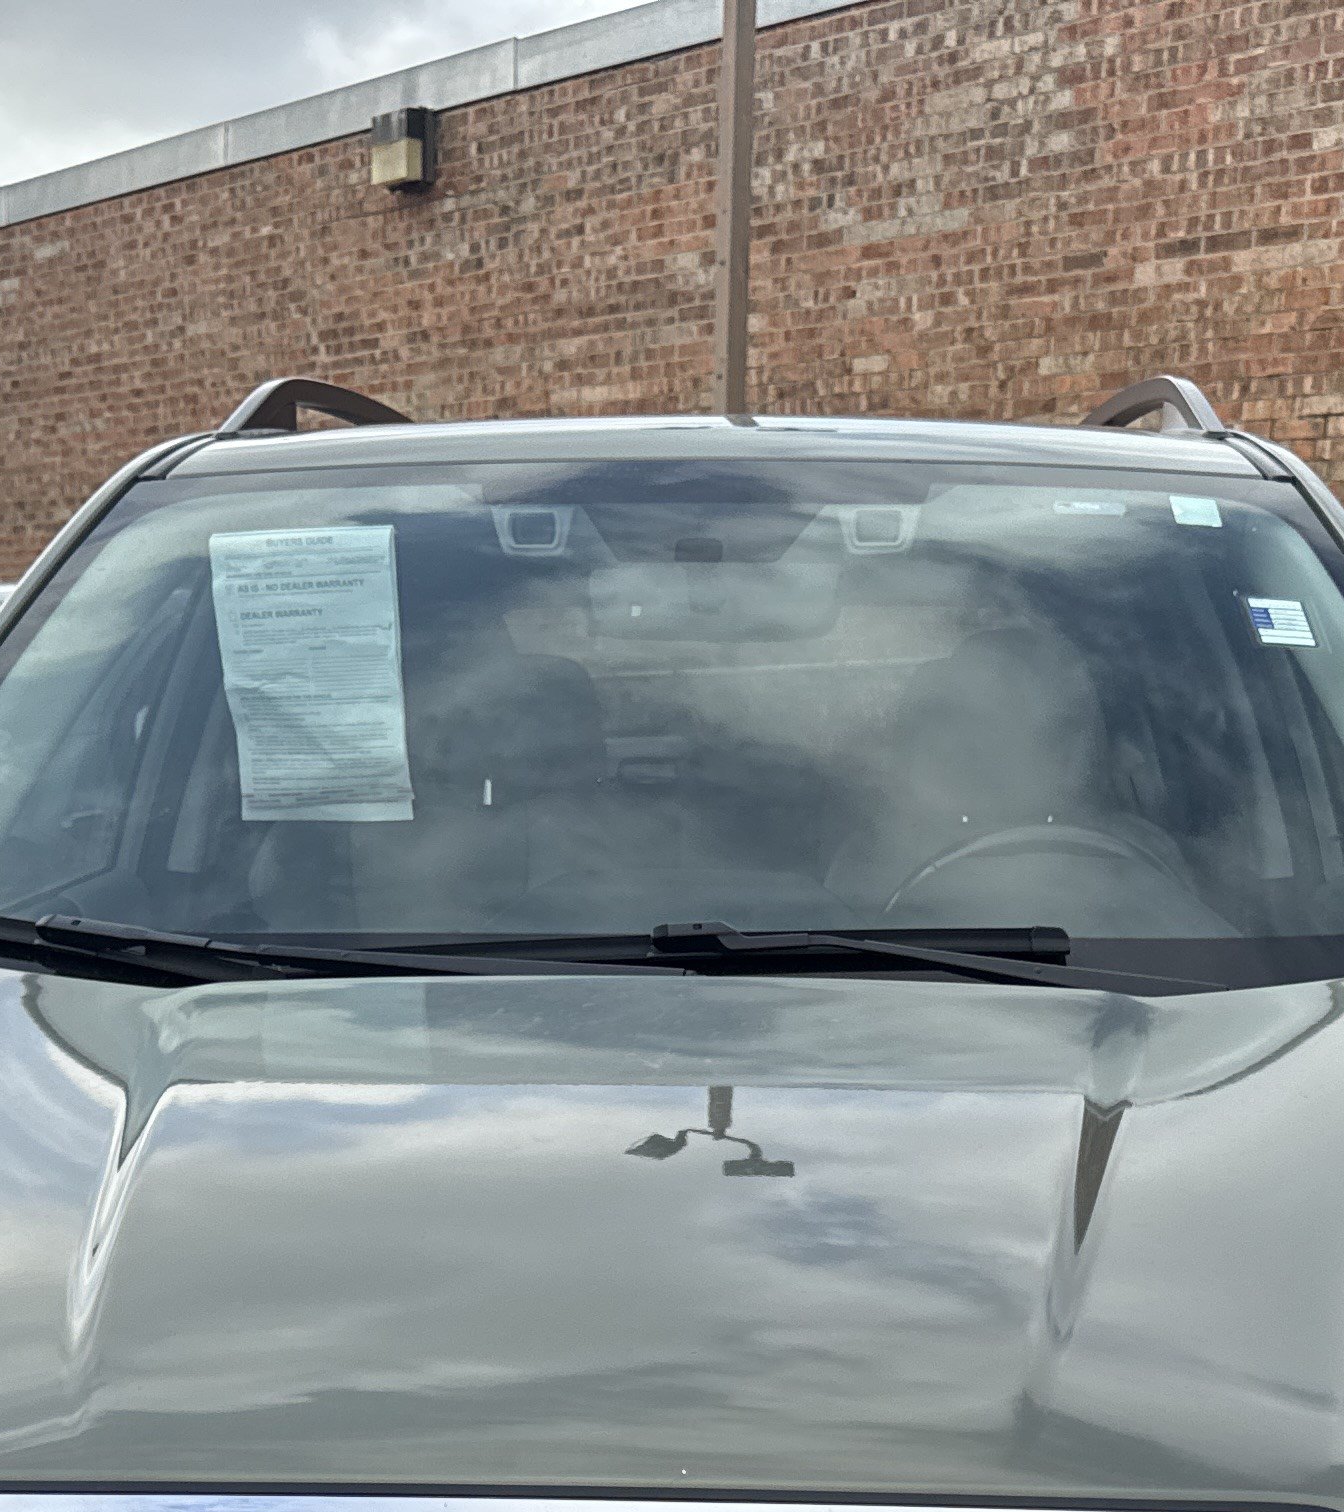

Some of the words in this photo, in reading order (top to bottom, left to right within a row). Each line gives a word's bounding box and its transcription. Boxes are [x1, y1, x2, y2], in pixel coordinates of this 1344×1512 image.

[266, 538, 302, 547] BUYERS
[306, 536, 333, 545] GUIDE
[238, 585, 249, 593] AS
[266, 583, 278, 592] NO
[280, 581, 315, 591] DEALER
[315, 579, 365, 590] WARRANTY
[240, 611, 273, 621] DEALER
[274, 608, 323, 619] WARRANTY
